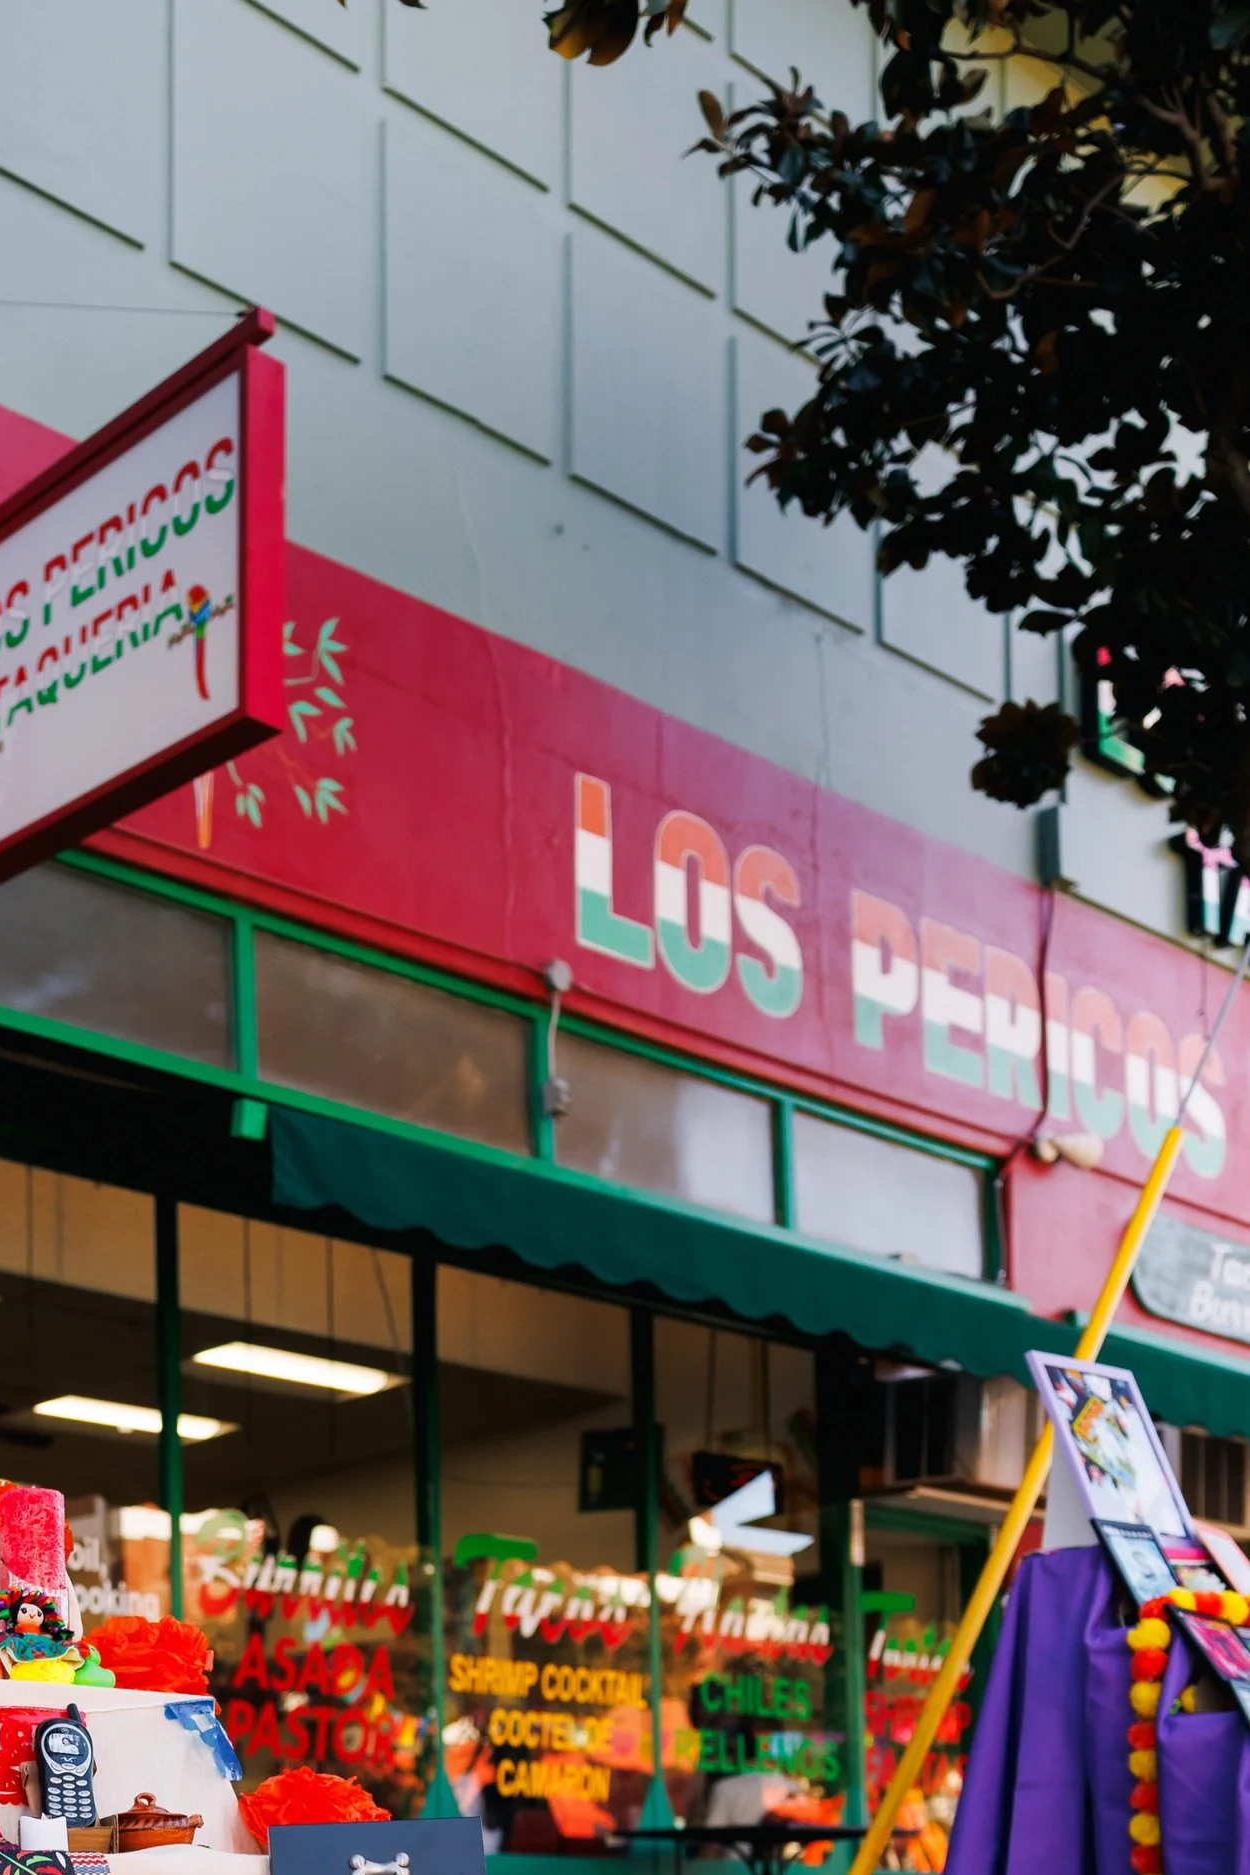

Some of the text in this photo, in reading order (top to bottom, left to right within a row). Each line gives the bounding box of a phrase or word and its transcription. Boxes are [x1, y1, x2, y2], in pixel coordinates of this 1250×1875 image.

[42, 436, 235, 627] PERICOS
[574, 771, 1228, 1180] LOS PERICOS
[232, 1632, 395, 1701] ASADA
[448, 1653, 648, 1710] SHRIMP COCKTAIL
[700, 1670, 813, 1721] CHILES
[226, 1698, 398, 1771] PASTOR
[674, 1728, 841, 1781] RELLENOS
